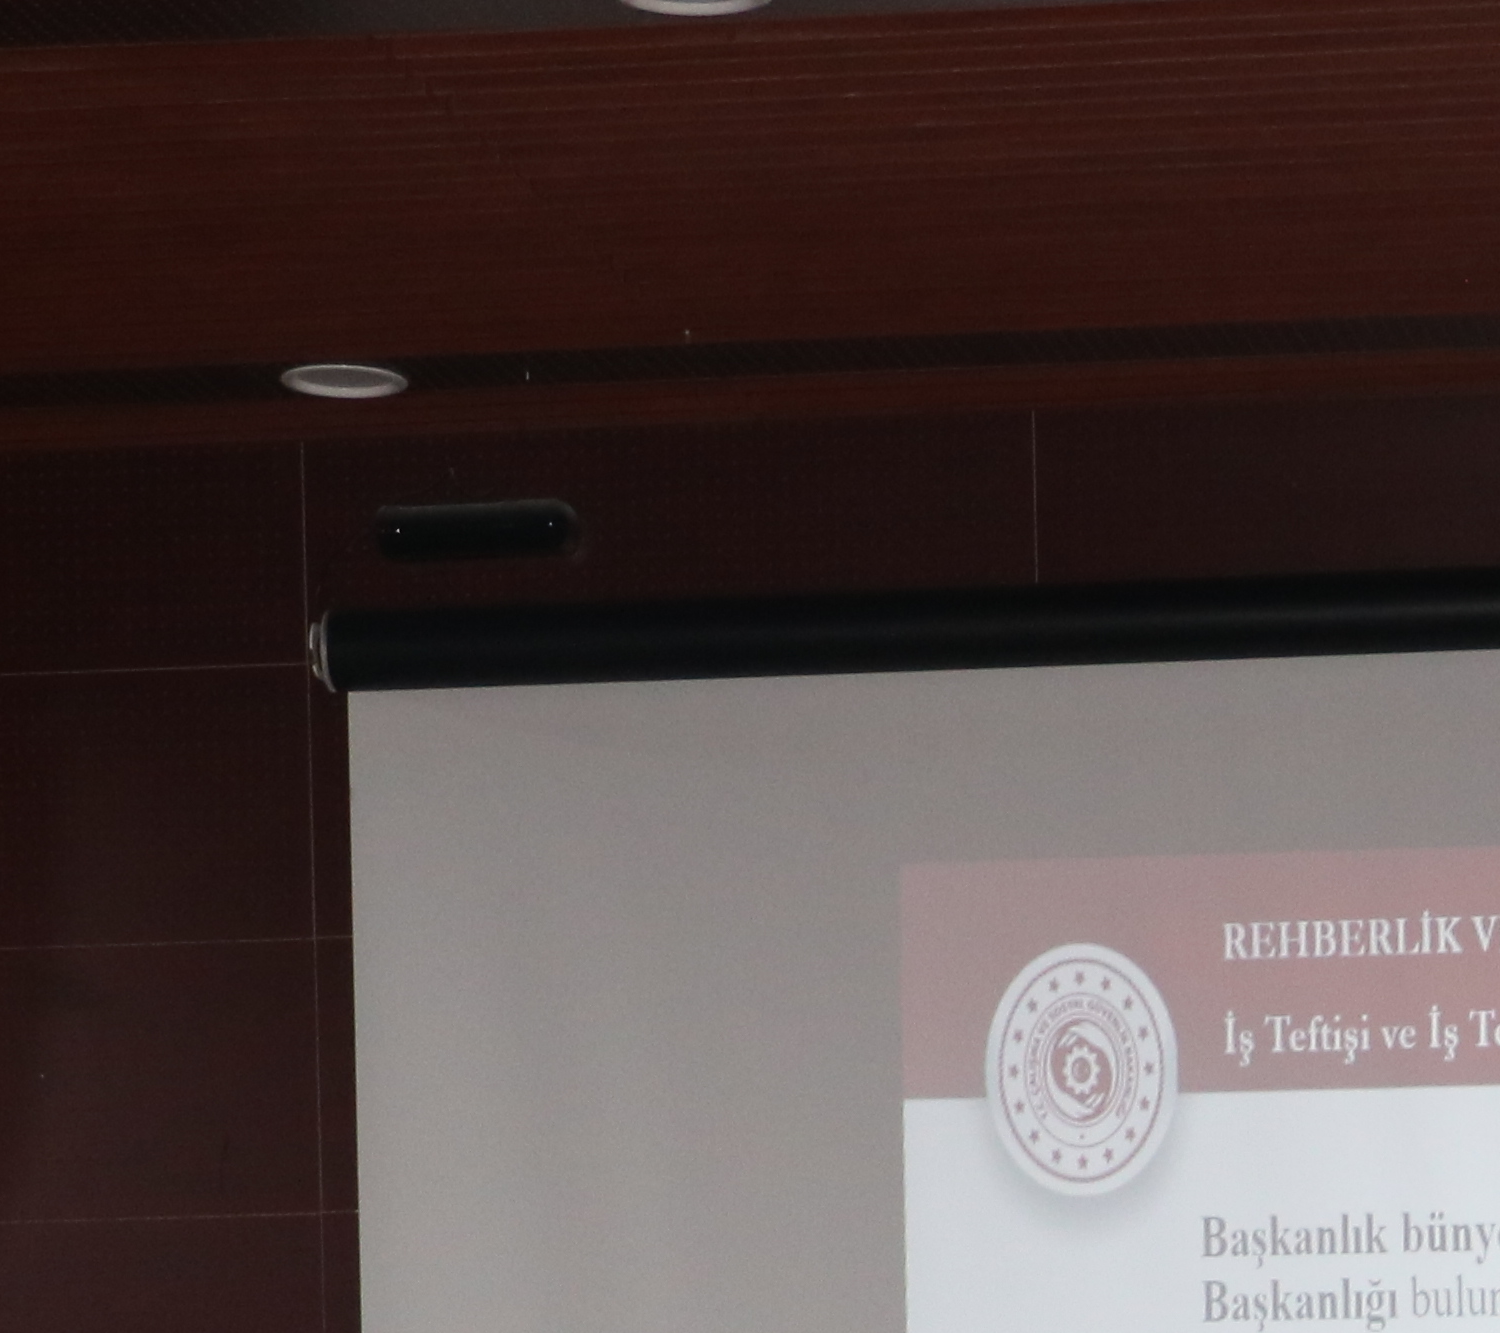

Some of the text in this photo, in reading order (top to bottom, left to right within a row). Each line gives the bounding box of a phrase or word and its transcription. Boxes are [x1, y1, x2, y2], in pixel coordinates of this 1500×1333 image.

[1222, 908, 1463, 961] REHBERLİK
[1223, 1010, 1255, 1066] İş
[1264, 1012, 1372, 1064] Teftişi
[1380, 1022, 1418, 1052] ve
[1427, 1004, 1461, 1061] İş
[1201, 1212, 1389, 1267] Başkanlık
[1201, 1277, 1399, 1333] Başkanlığı
